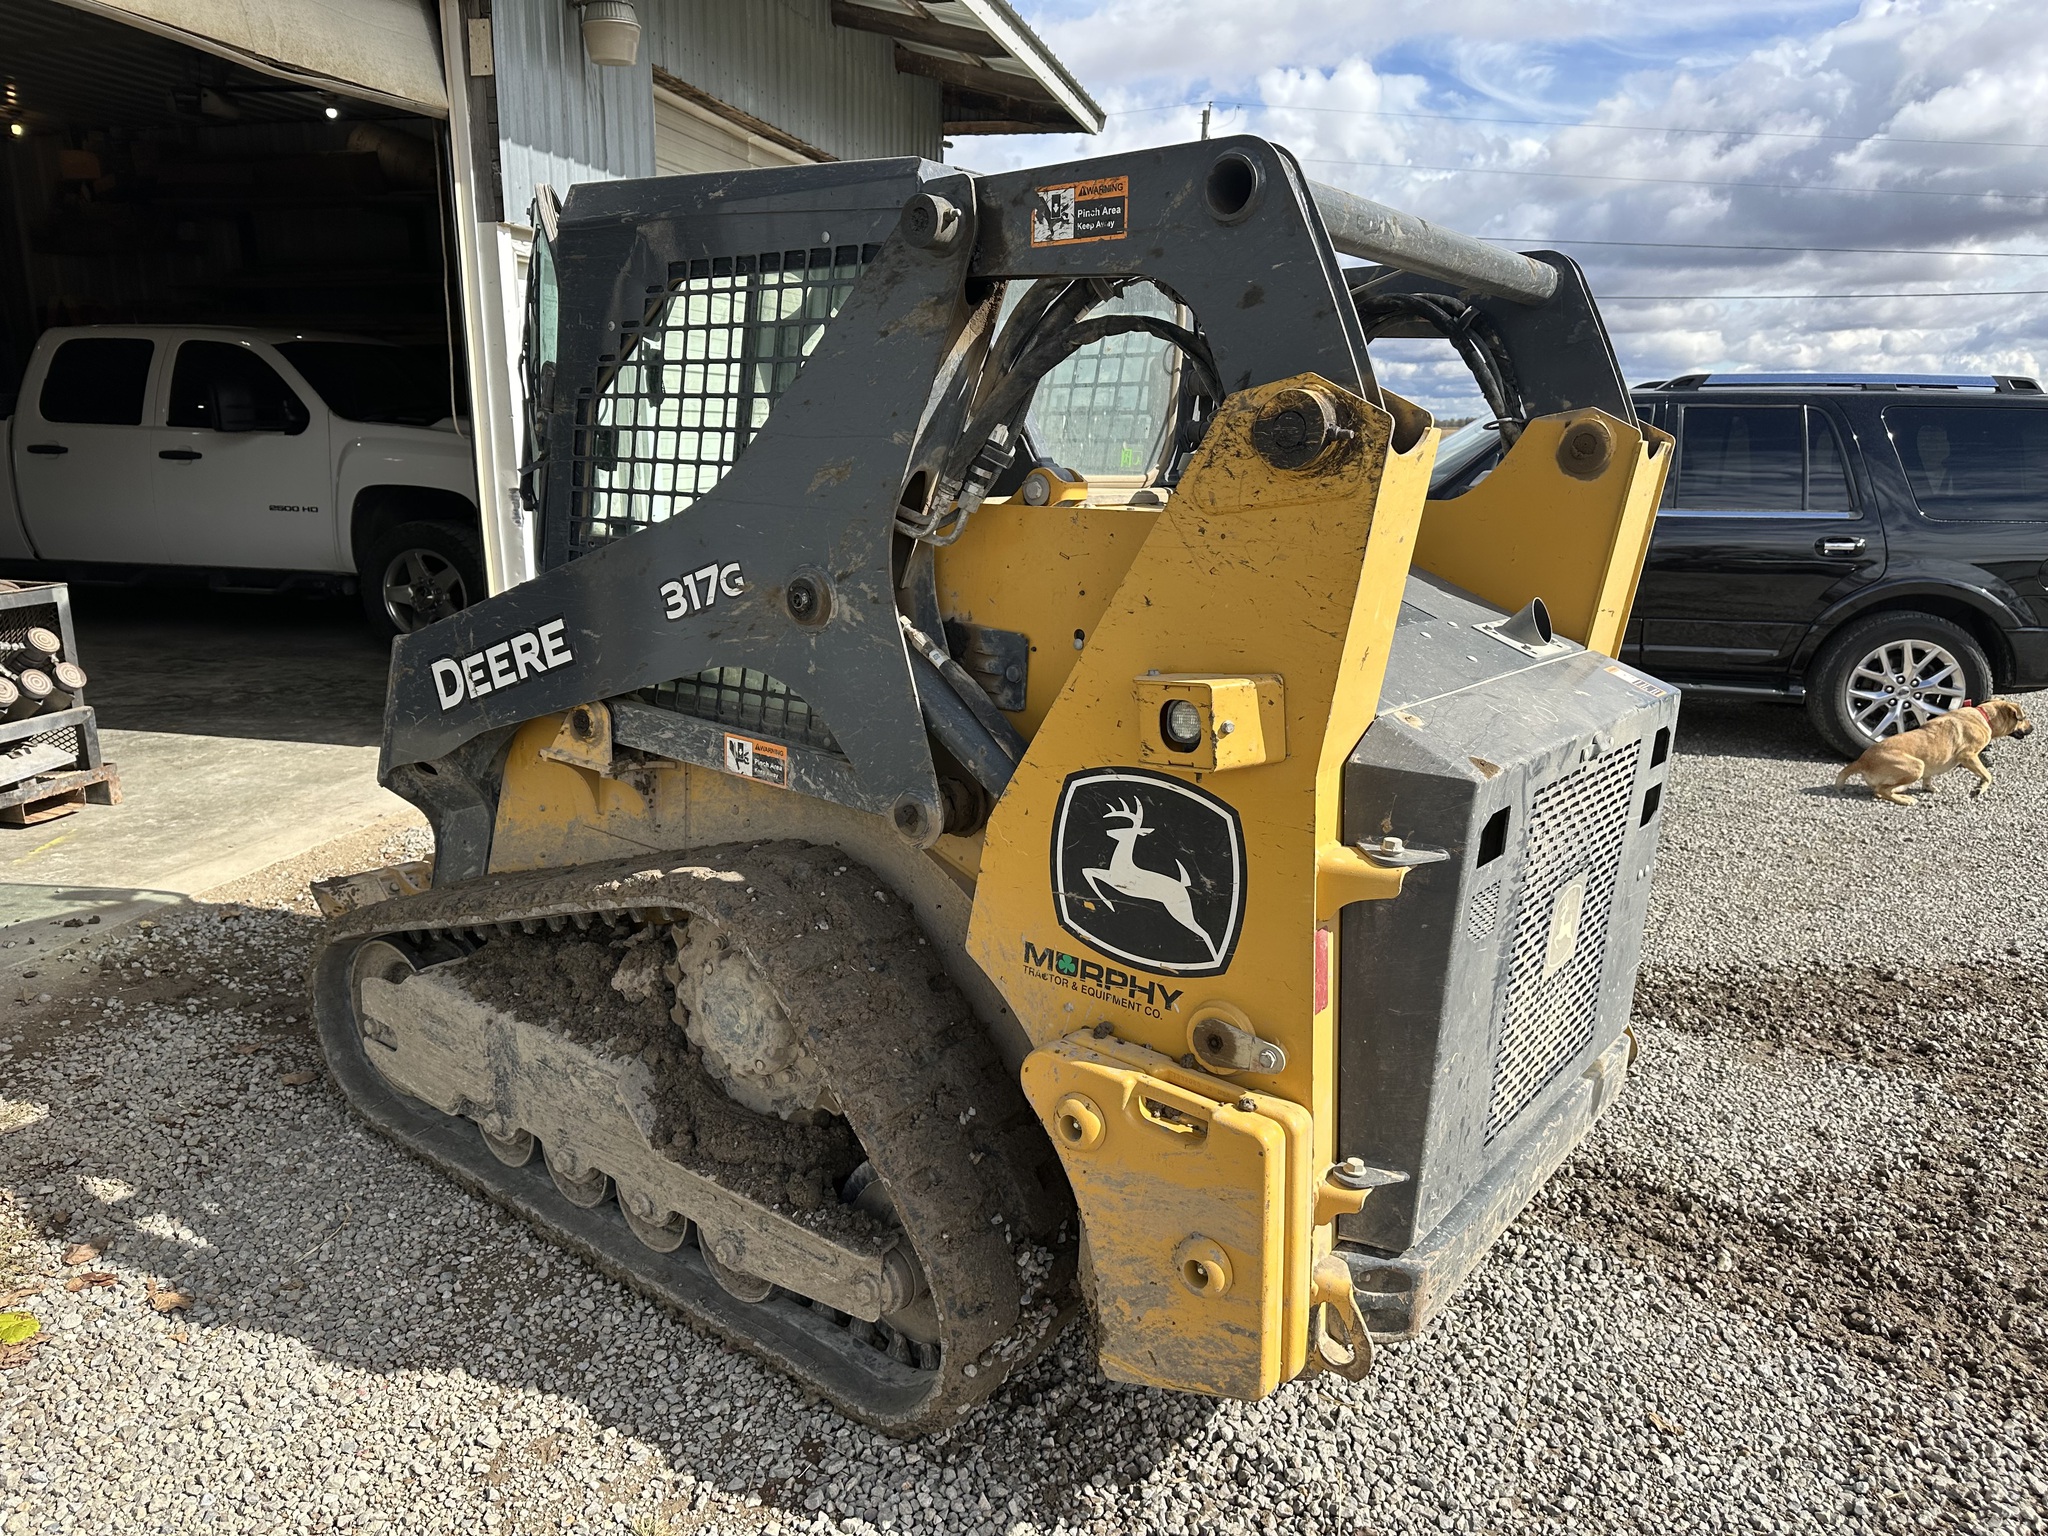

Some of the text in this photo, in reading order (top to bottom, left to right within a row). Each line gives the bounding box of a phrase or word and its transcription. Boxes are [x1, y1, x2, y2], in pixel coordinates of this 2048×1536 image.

[1087, 183, 1123, 195] WARNING
[1077, 206, 1121, 219] Pinch Area
[1077, 222, 1095, 231] Keep
[269, 504, 300, 512] 2500
[659, 562, 745, 620] 317G
[431, 618, 573, 710] DEERE
[1023, 941, 1184, 1011] MURPHY
[1023, 965, 1163, 1020] TRACTOR & EQUIPMENT CO.
